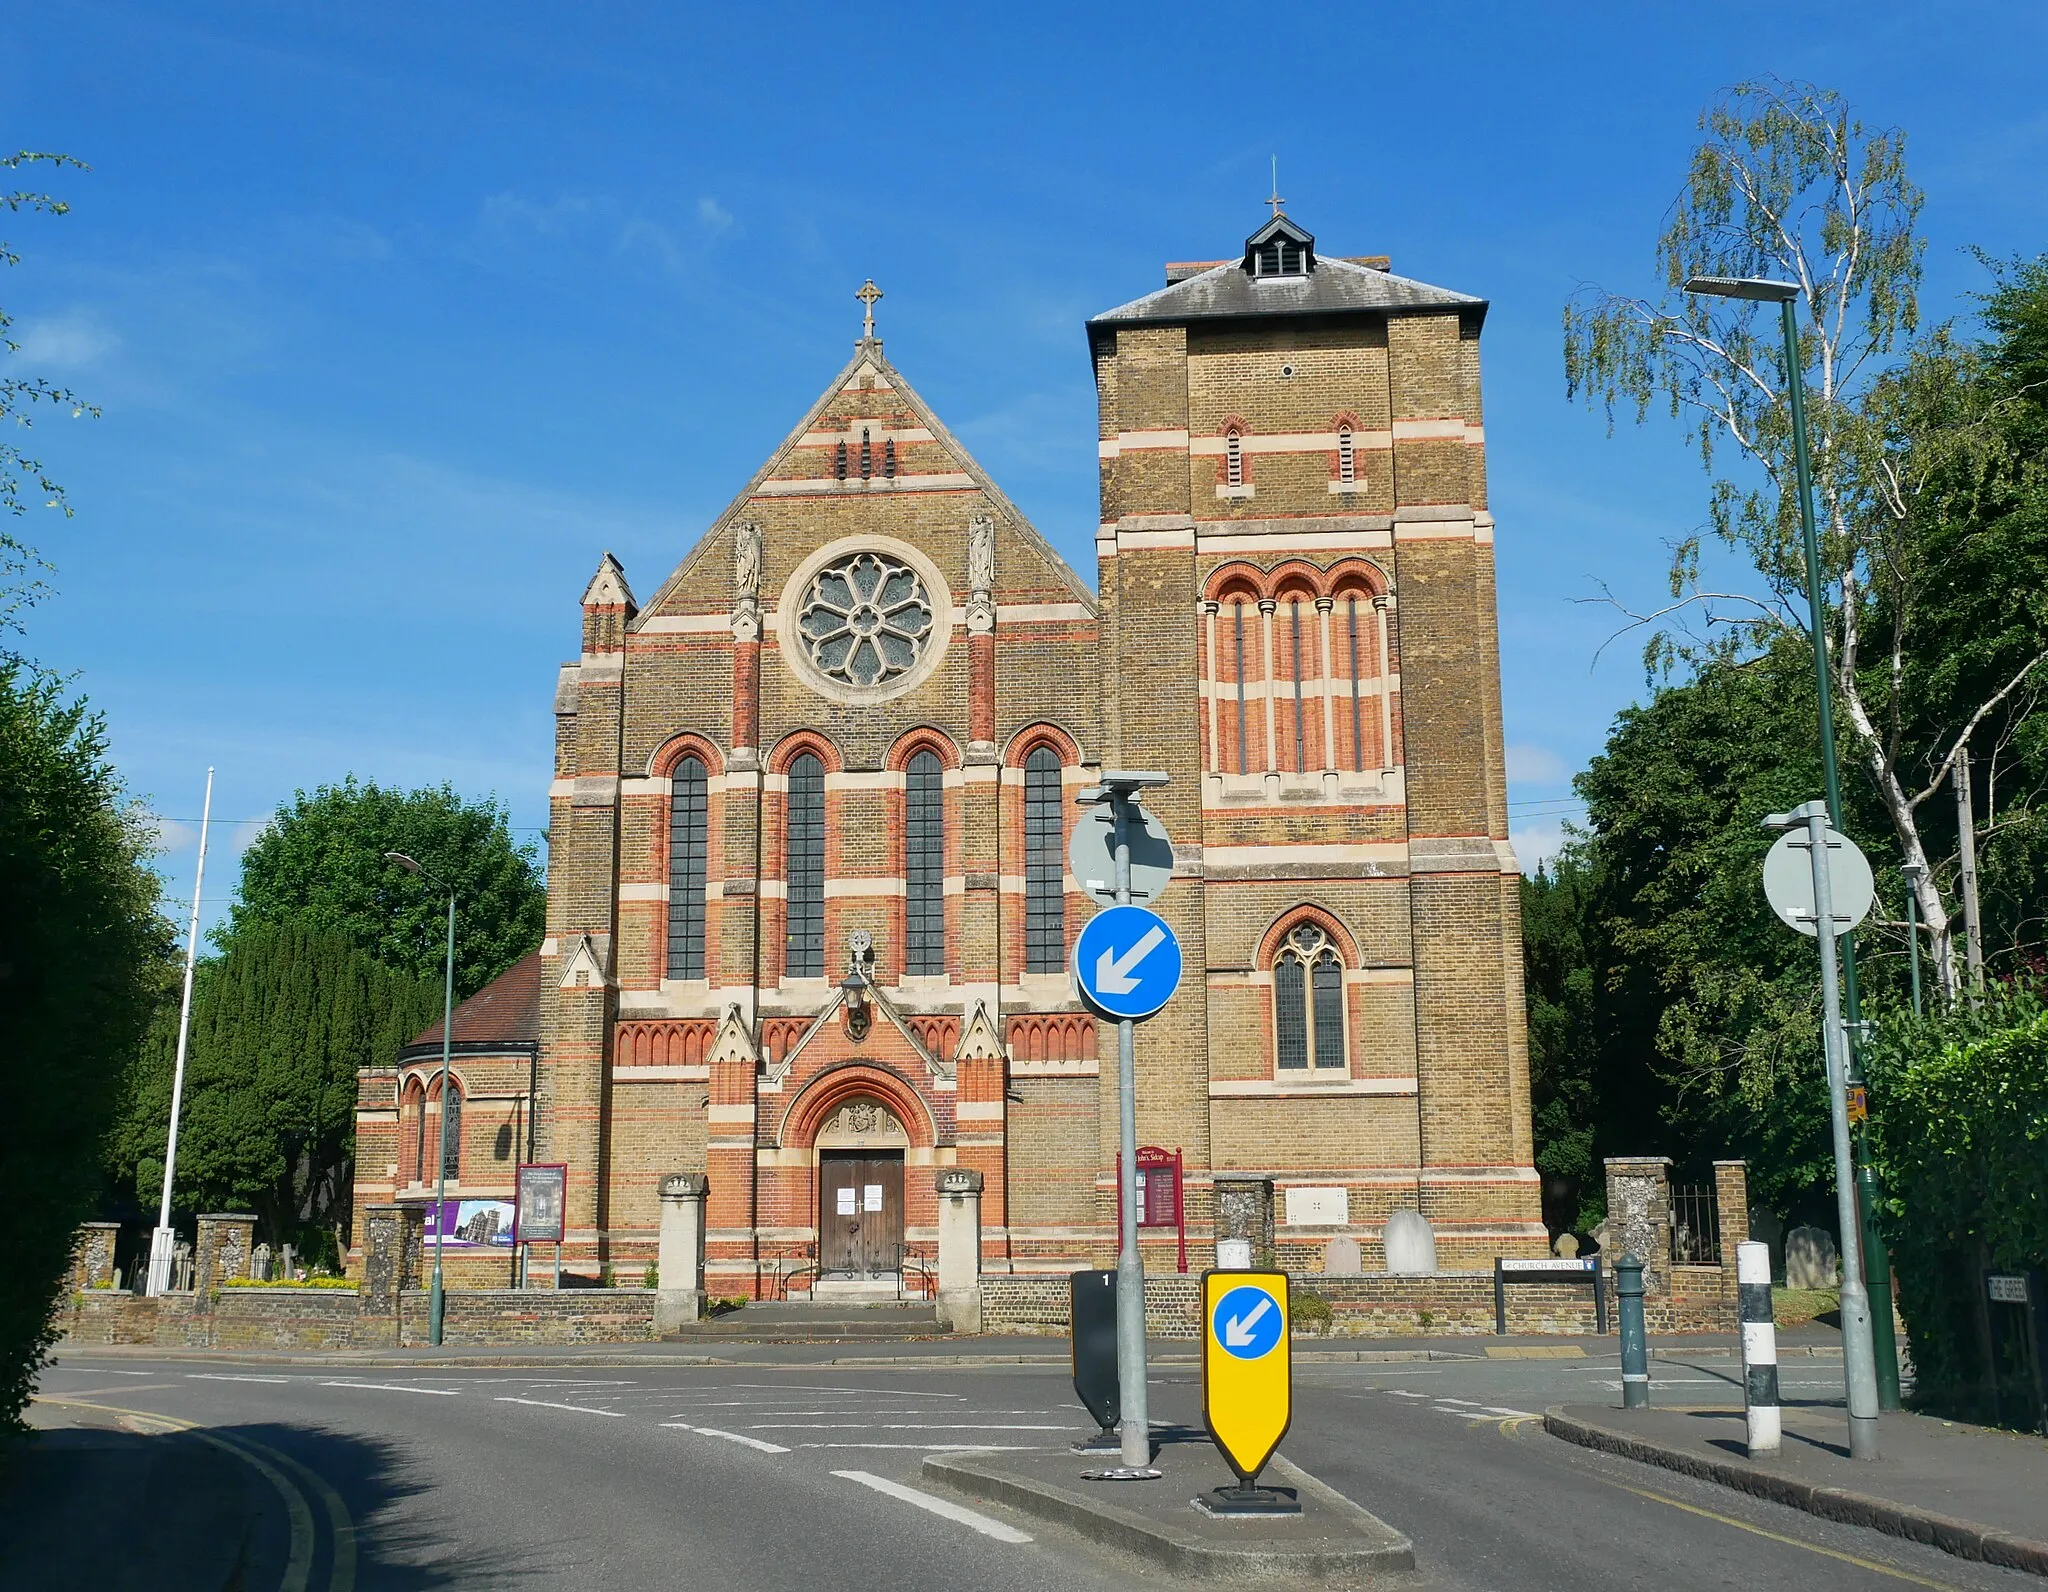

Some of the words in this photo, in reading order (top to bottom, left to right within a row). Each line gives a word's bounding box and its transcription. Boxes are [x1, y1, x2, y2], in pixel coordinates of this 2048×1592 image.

[1150, 1153, 1164, 1162] Sidcup
[1102, 1273, 1109, 1286] 1
[1989, 1279, 2003, 1298] THE
